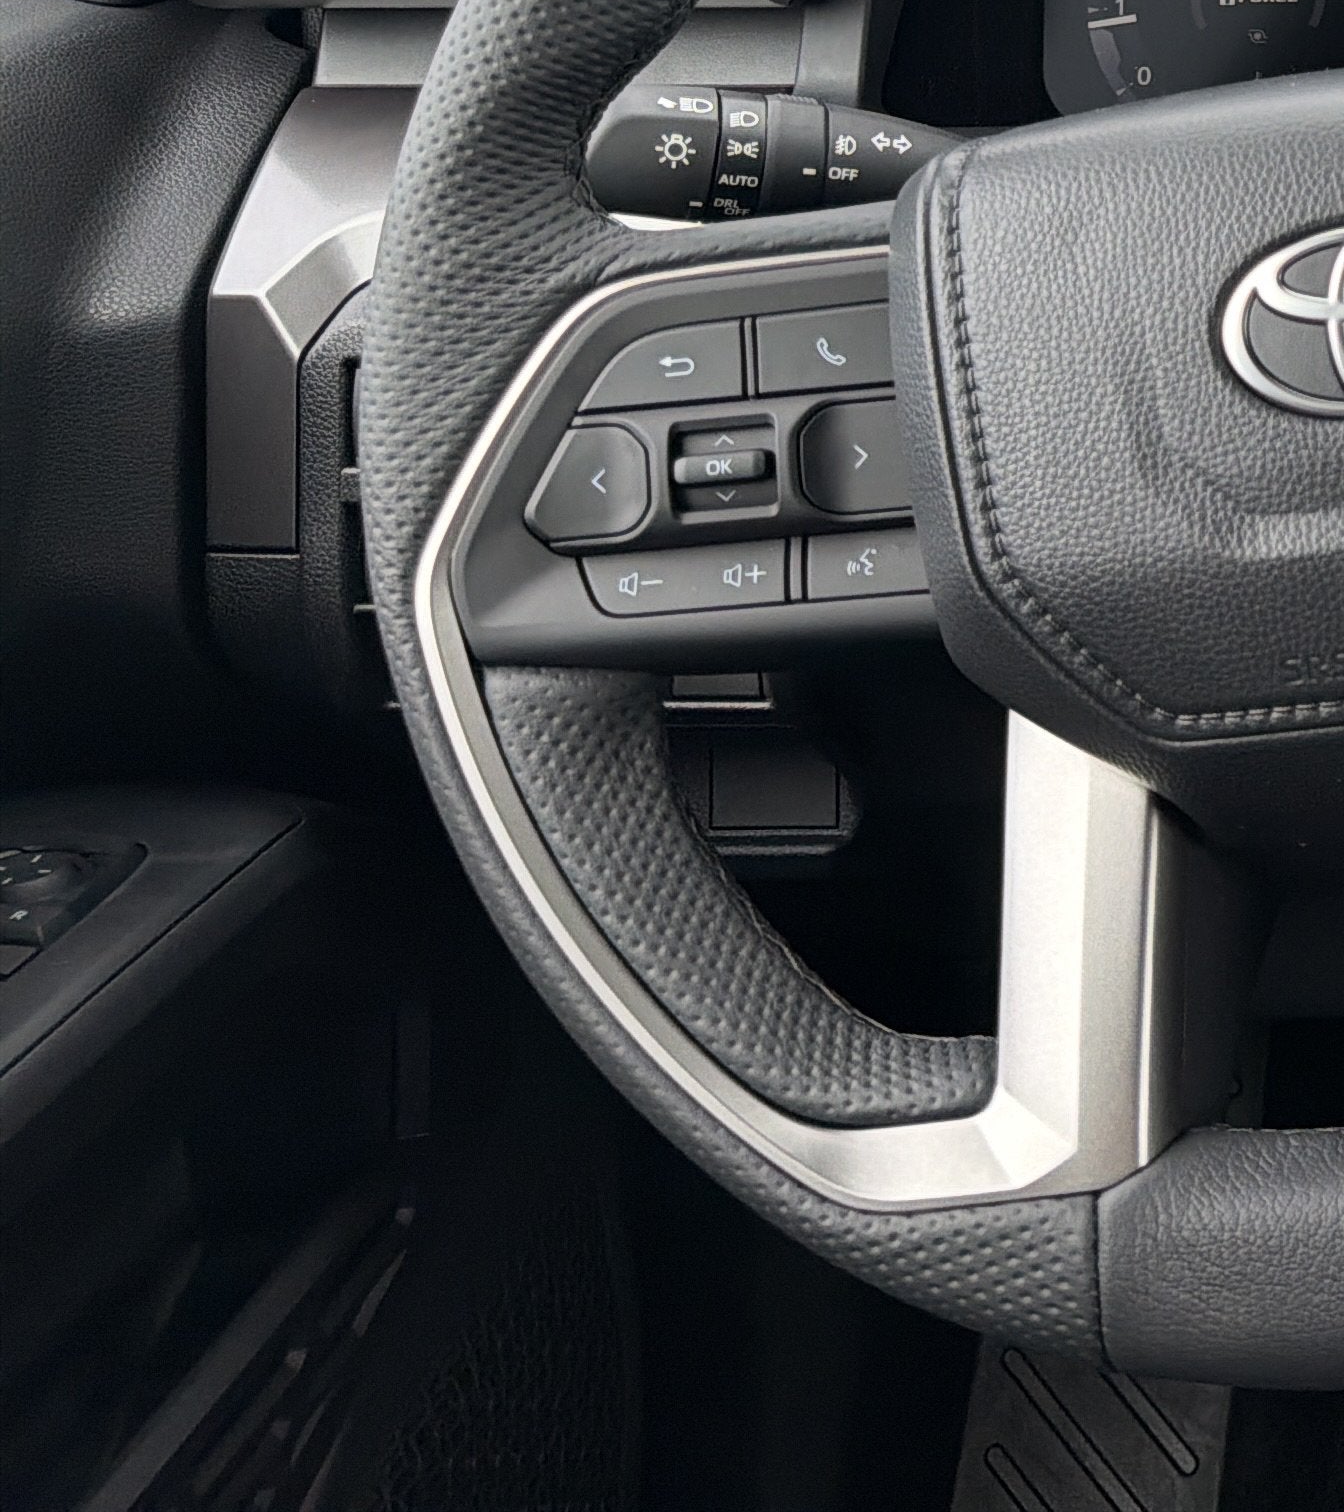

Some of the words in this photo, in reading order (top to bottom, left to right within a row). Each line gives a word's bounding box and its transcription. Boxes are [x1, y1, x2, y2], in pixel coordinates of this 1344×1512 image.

[1137, 66, 1151, 86] 0
[719, 174, 759, 188] AUTO
[829, 167, 859, 182] OFF
[714, 198, 740, 209] DRL
[724, 207, 750, 217] OFF
[706, 459, 731, 476] OK
